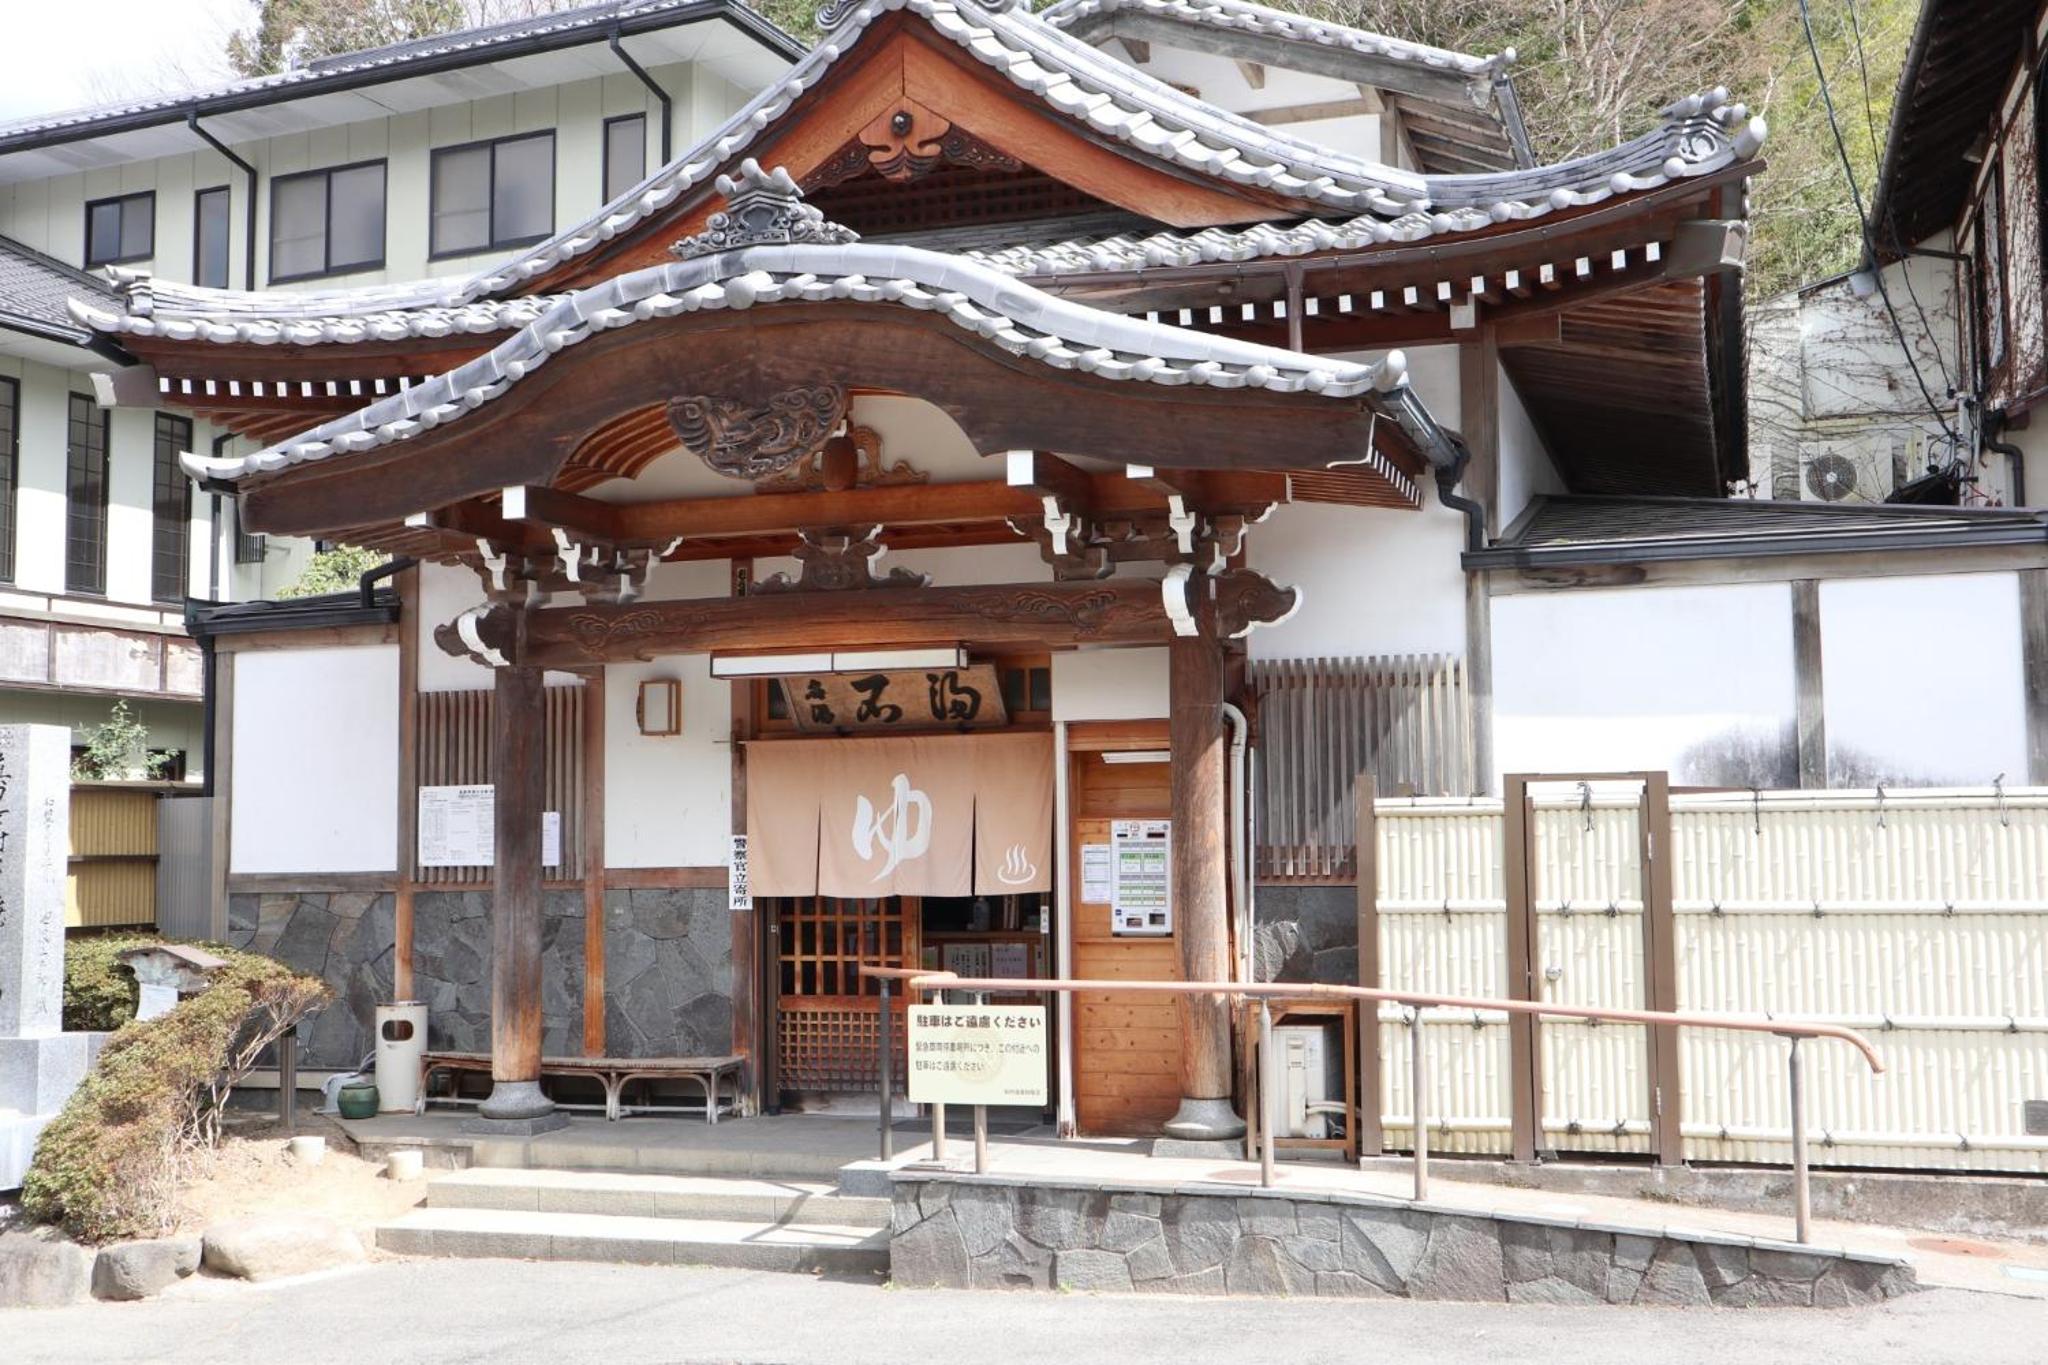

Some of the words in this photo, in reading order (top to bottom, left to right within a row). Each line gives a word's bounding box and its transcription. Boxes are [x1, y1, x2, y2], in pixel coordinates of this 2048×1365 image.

[853, 773, 933, 883] ゆ
[733, 838, 747, 907] 警察官立寄所
[916, 1014, 1041, 1028] 駐車はご遠慮ください
